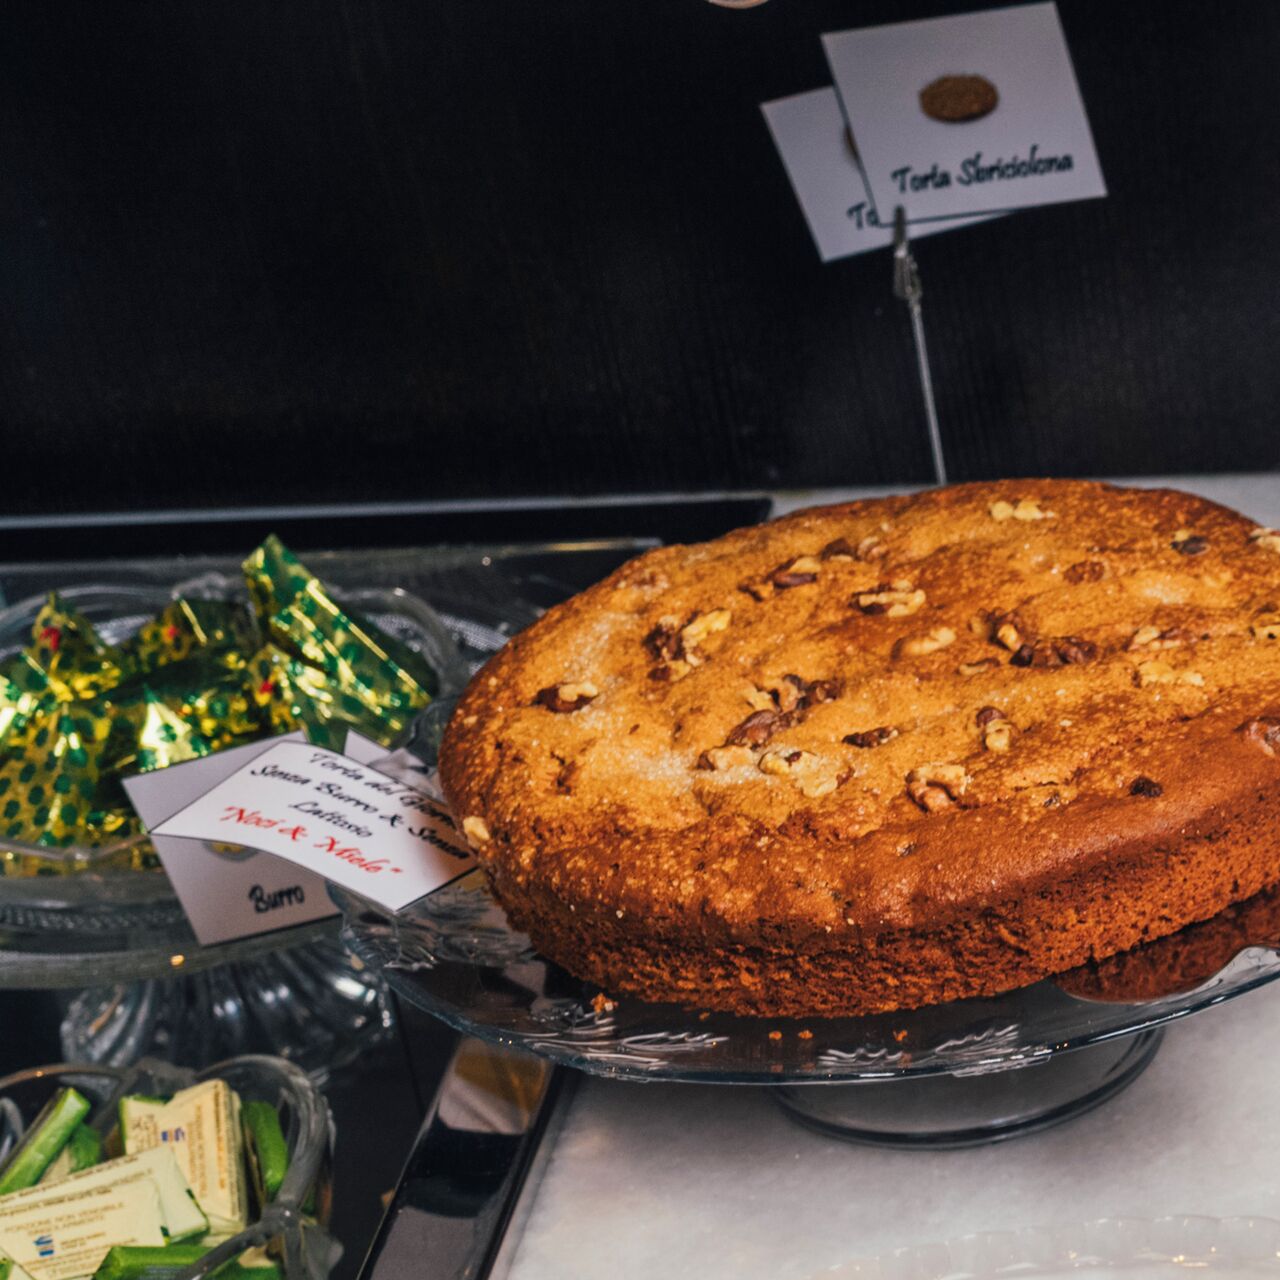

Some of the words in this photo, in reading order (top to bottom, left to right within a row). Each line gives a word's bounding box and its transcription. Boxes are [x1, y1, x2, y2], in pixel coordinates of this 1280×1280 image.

[890, 165, 951, 193] Torta
[956, 144, 1073, 187] Sbriciolona
[250, 765, 311, 785] Senza
[315, 782, 379, 814] Burro
[378, 813, 404, 829] &
[310, 752, 364, 780] Torta
[400, 794, 457, 832] Giorn
[278, 824, 309, 841] &
[288, 801, 373, 838] Lattosio
[248, 884, 305, 913] Burro
